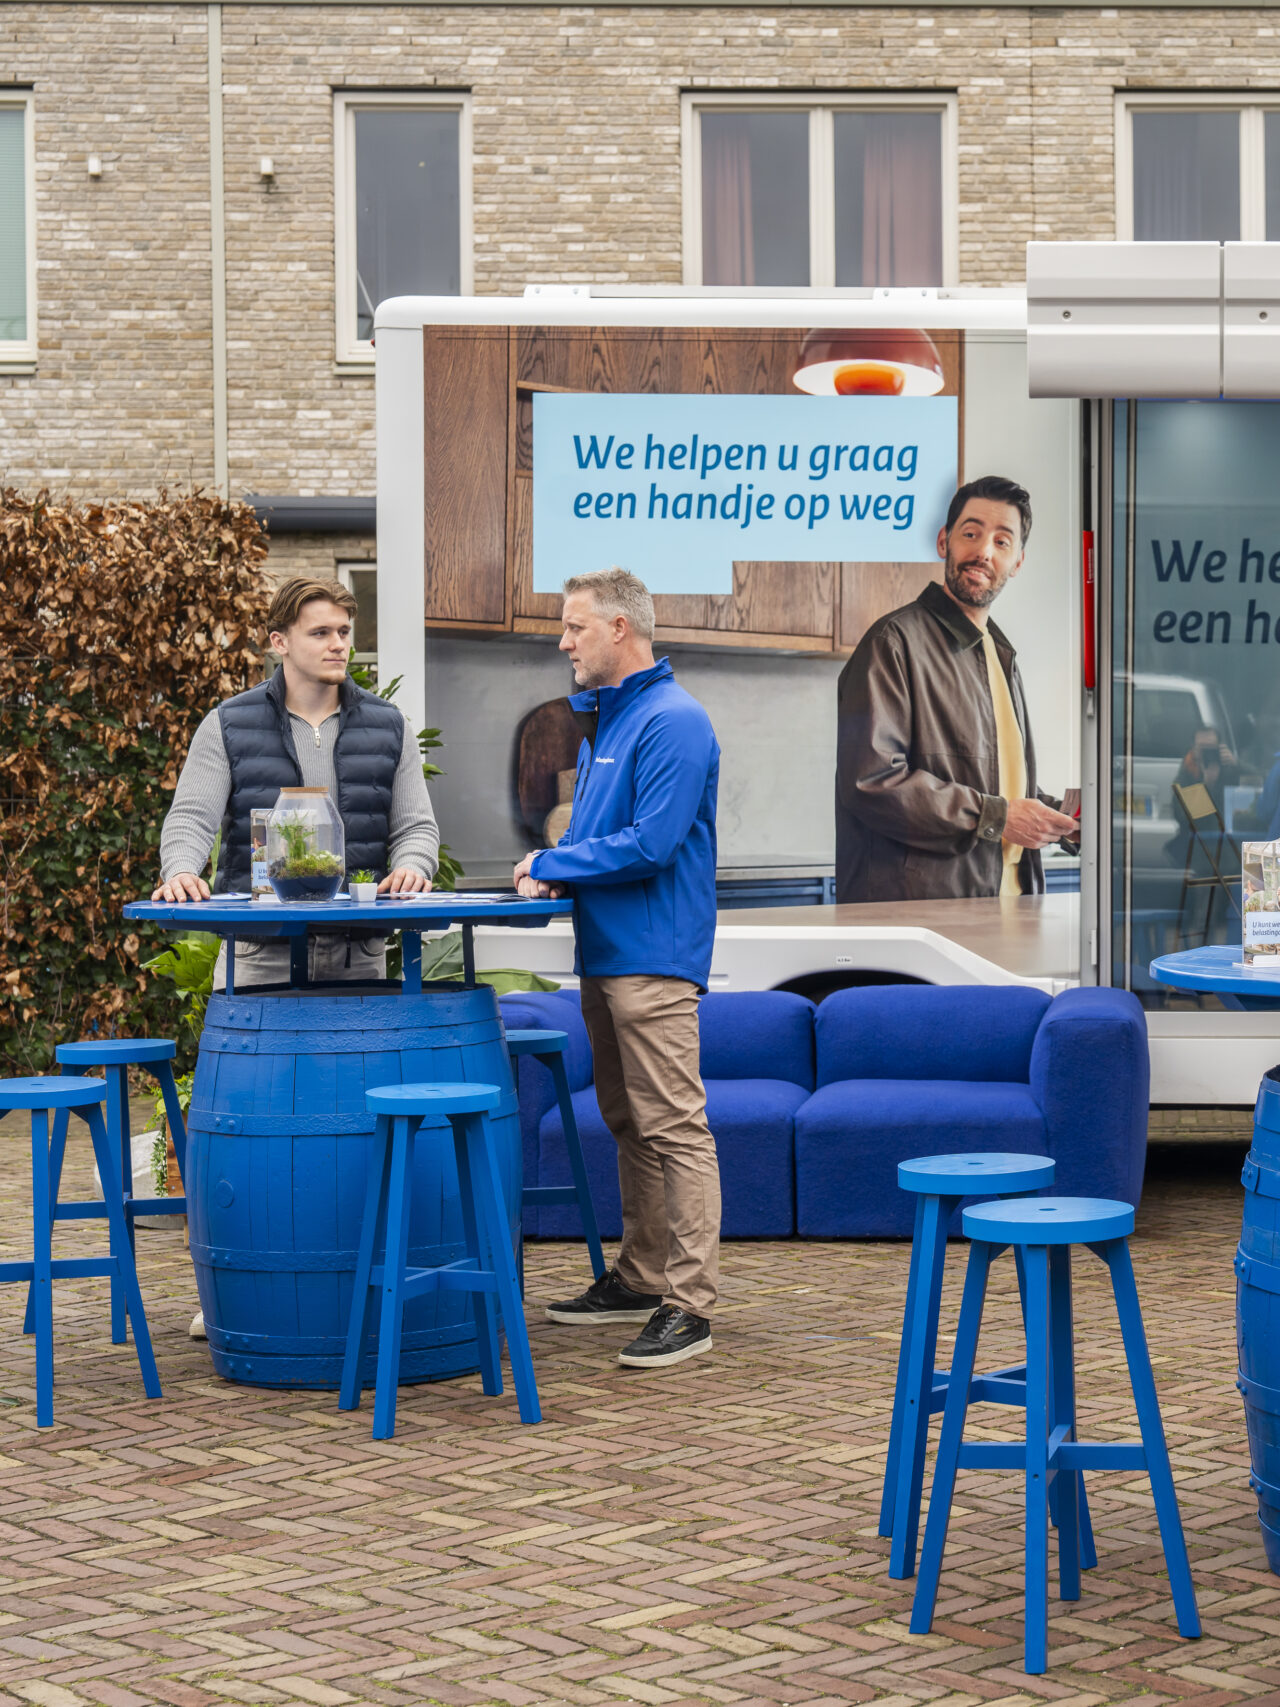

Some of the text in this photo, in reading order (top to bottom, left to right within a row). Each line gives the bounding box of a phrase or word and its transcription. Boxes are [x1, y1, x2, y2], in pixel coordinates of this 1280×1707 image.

[573, 433, 919, 481] We helpen u graag
[573, 482, 915, 531] een handje op weg
[1151, 539, 1228, 584] We
[1153, 610, 1232, 644] een
[1258, 920, 1271, 928] kunt
